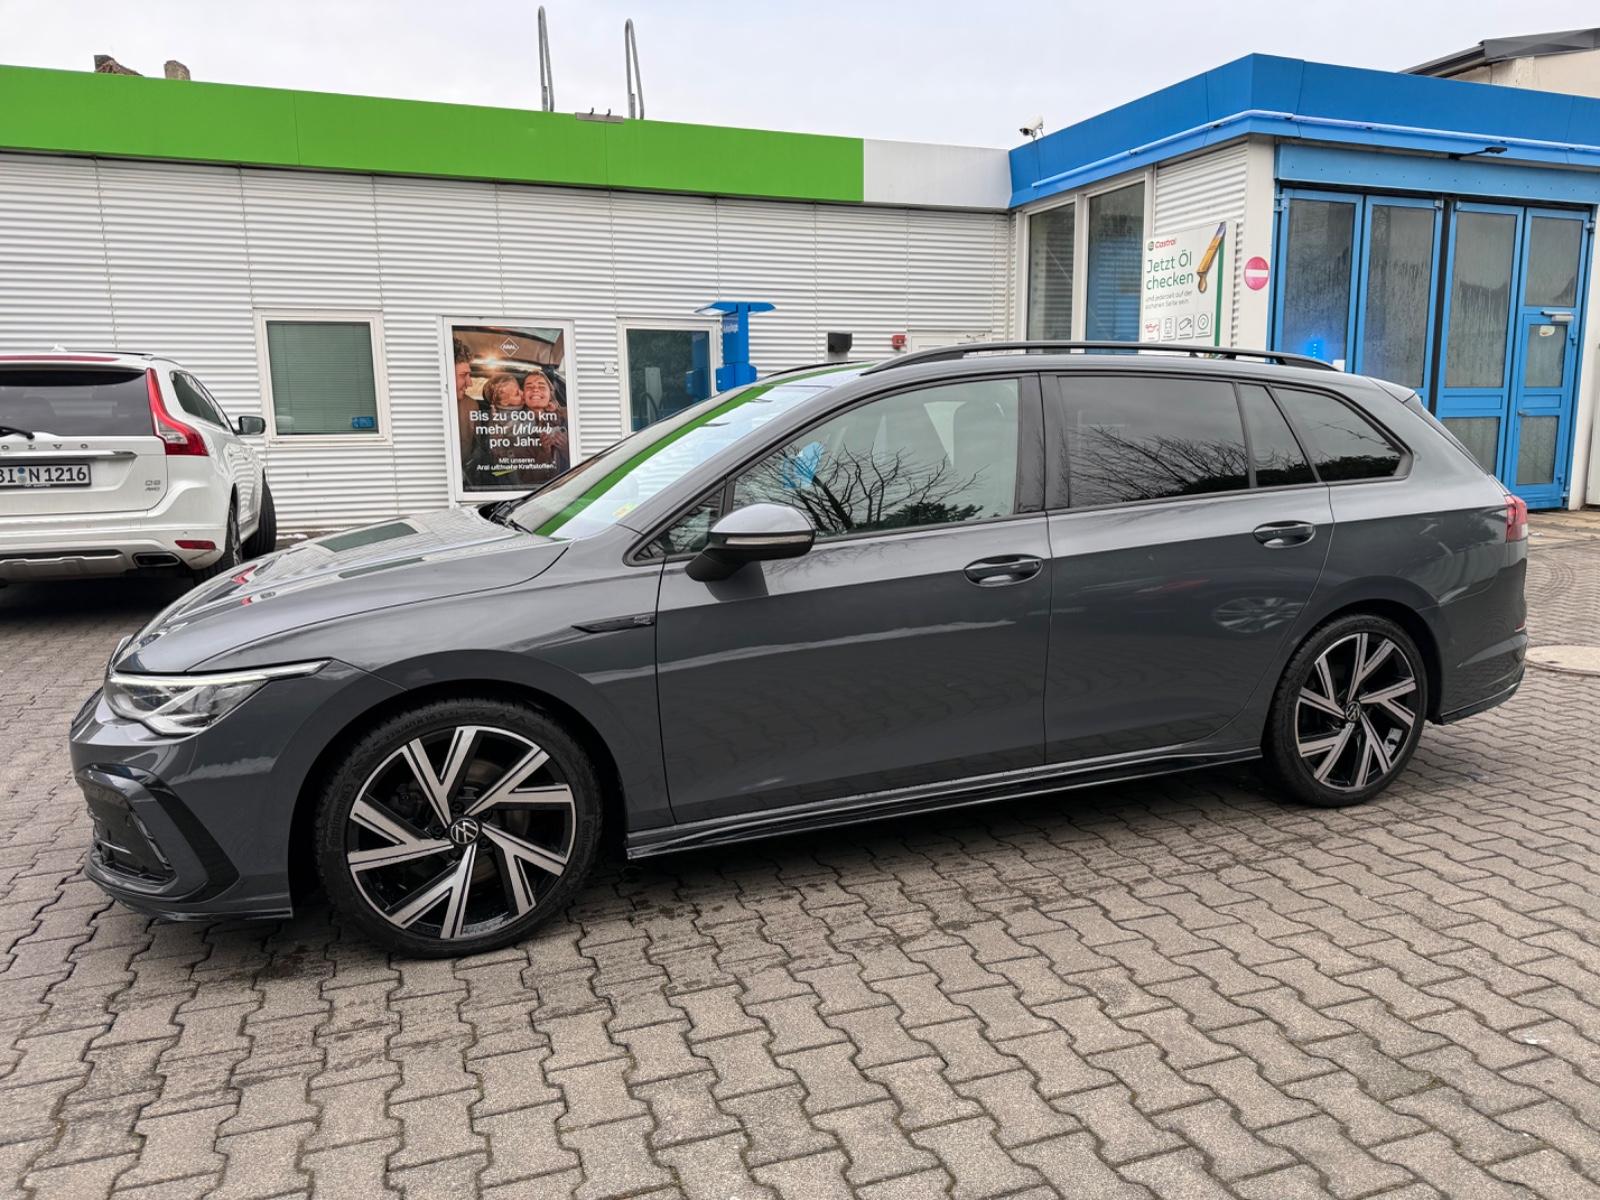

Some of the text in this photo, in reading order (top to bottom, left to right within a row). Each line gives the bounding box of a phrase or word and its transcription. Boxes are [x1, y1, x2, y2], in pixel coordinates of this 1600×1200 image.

[1155, 239, 1176, 248] Castrol
[1146, 249, 1192, 274] Jetzt Öl
[1145, 271, 1194, 290] checken
[469, 410, 557, 422] Bis zu 600 km
[475, 422, 553, 436] mehr Urlaub
[1, 443, 89, 451] OLVO
[489, 436, 542, 449] pro Jahr.
[28, 467, 40, 482] N
[44, 466, 87, 483] 1216
